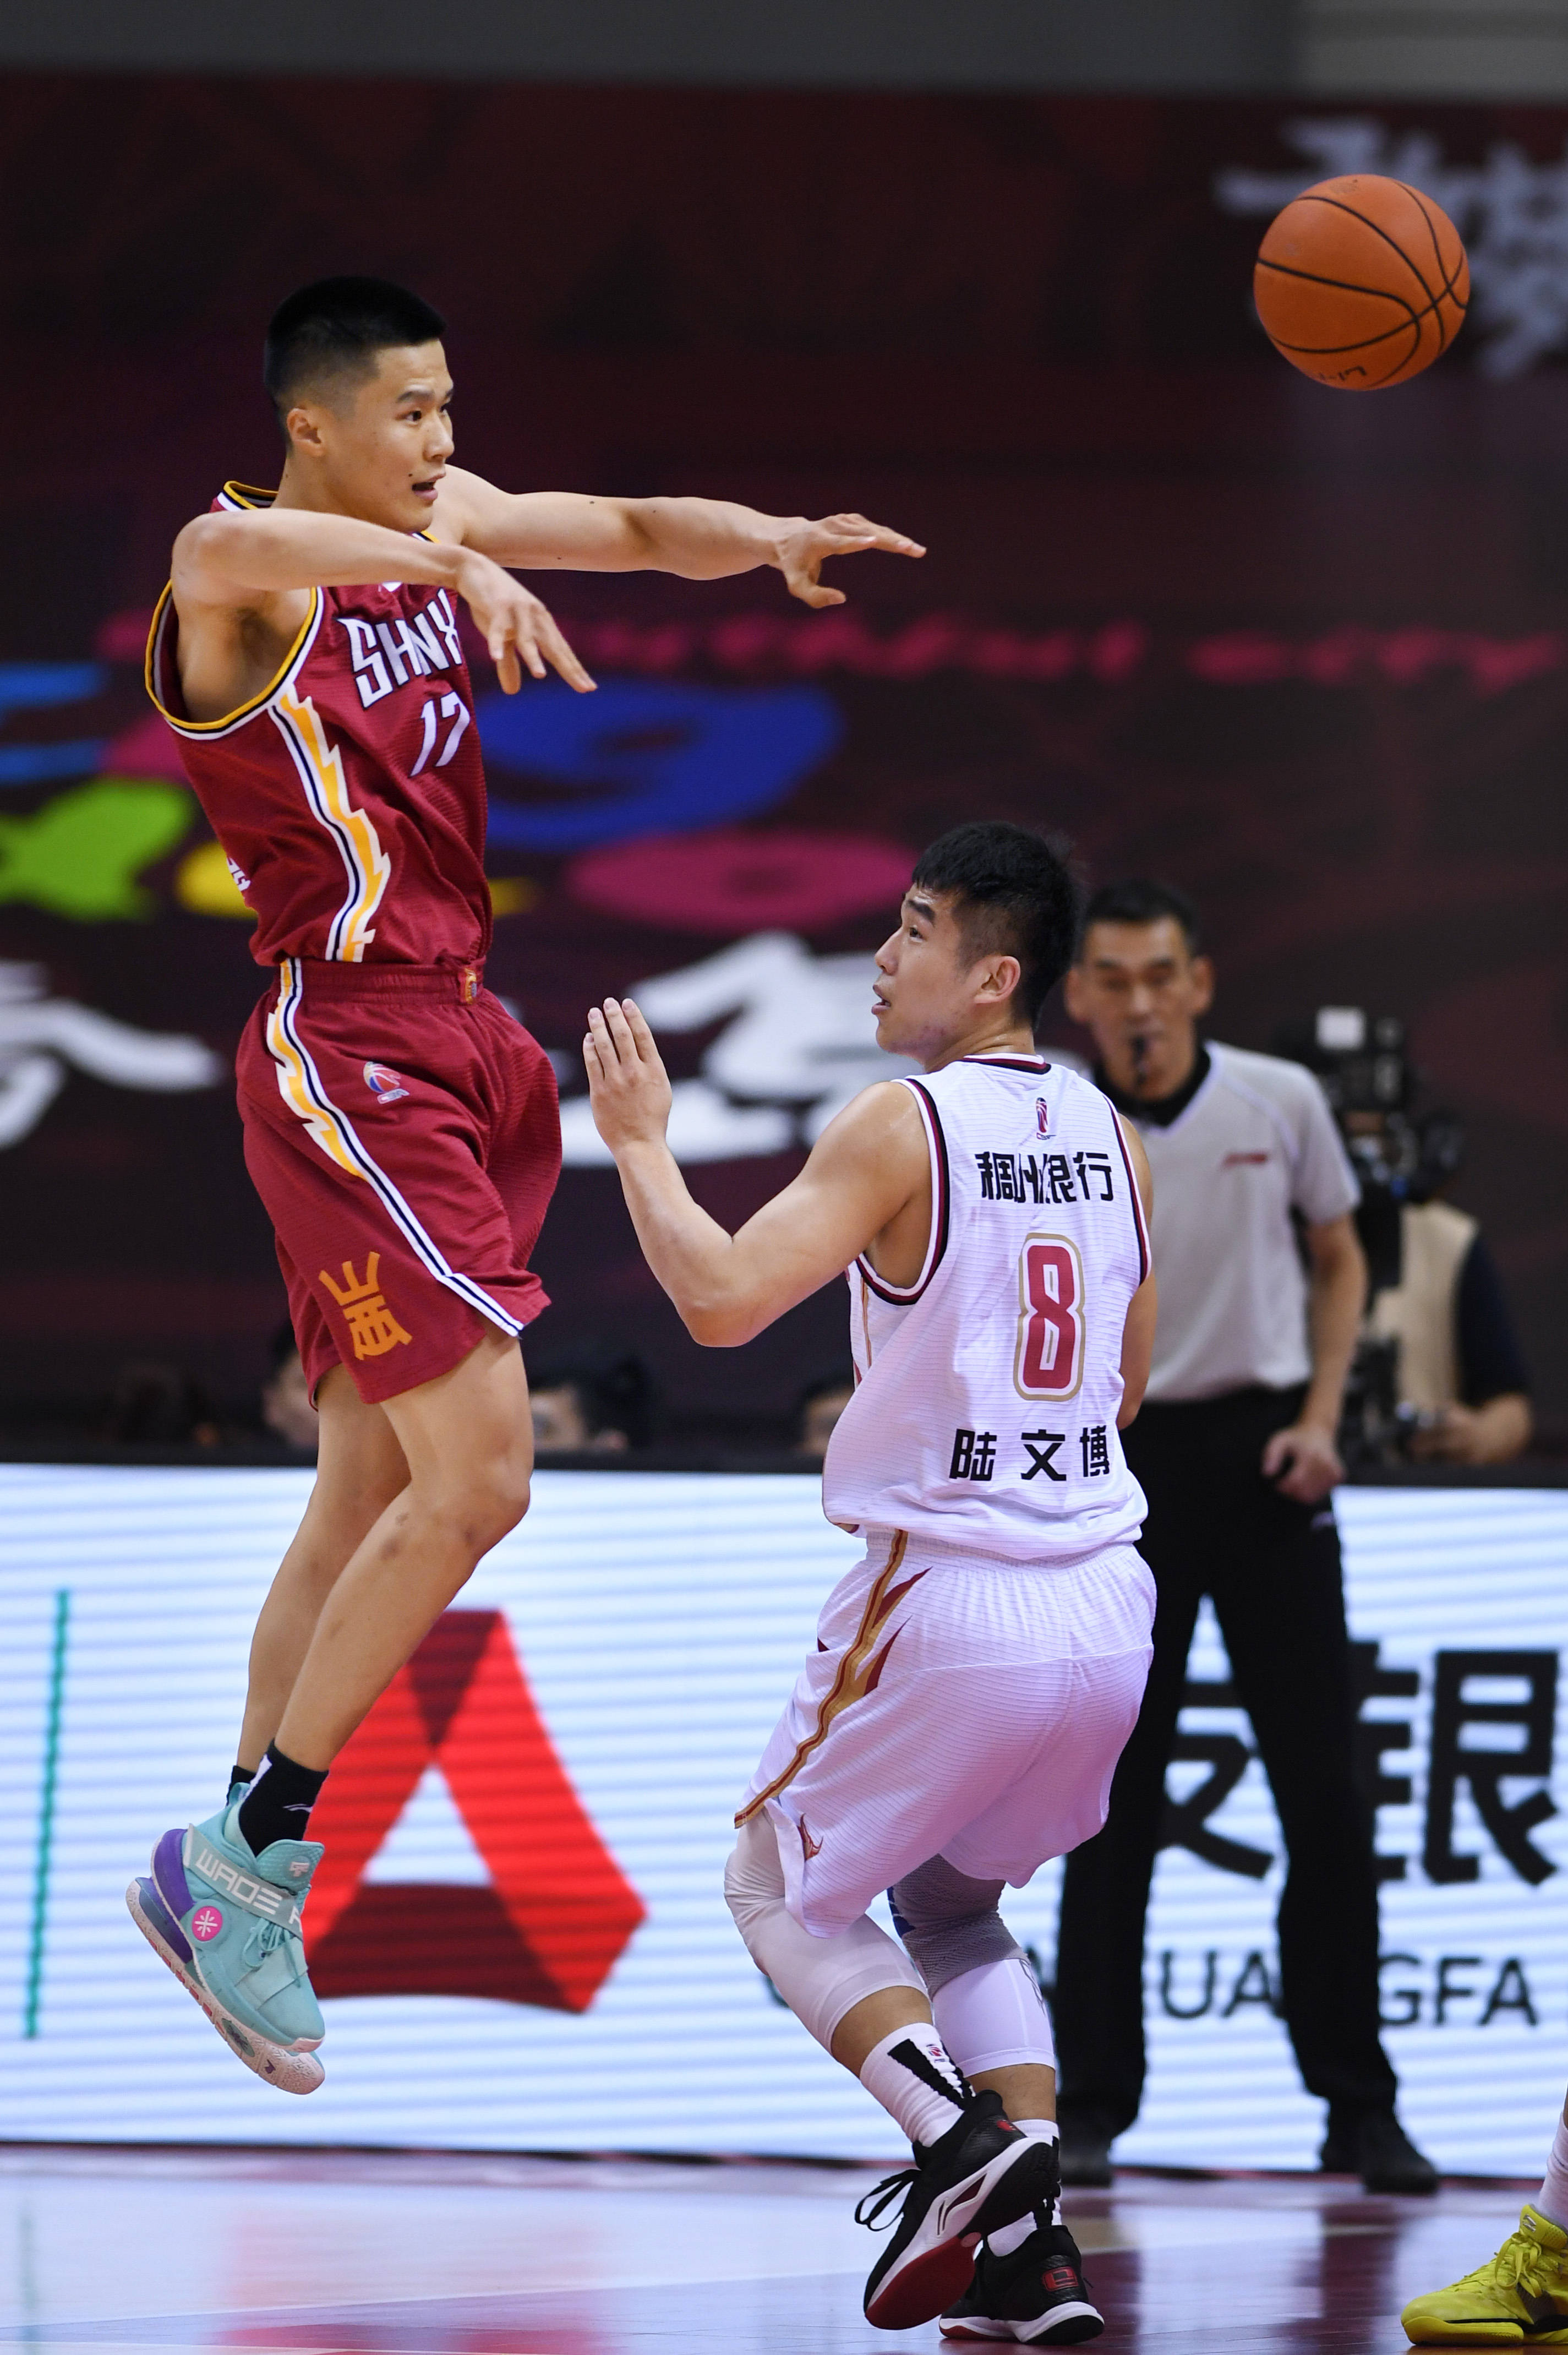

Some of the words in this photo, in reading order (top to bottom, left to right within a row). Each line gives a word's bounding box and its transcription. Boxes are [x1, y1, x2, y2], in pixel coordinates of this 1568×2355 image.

[408, 690, 470, 777] 17
[1013, 1232, 1086, 1401] 8
[195, 1848, 283, 1915] WADE
[1157, 1948, 1538, 2027] UAGFA
